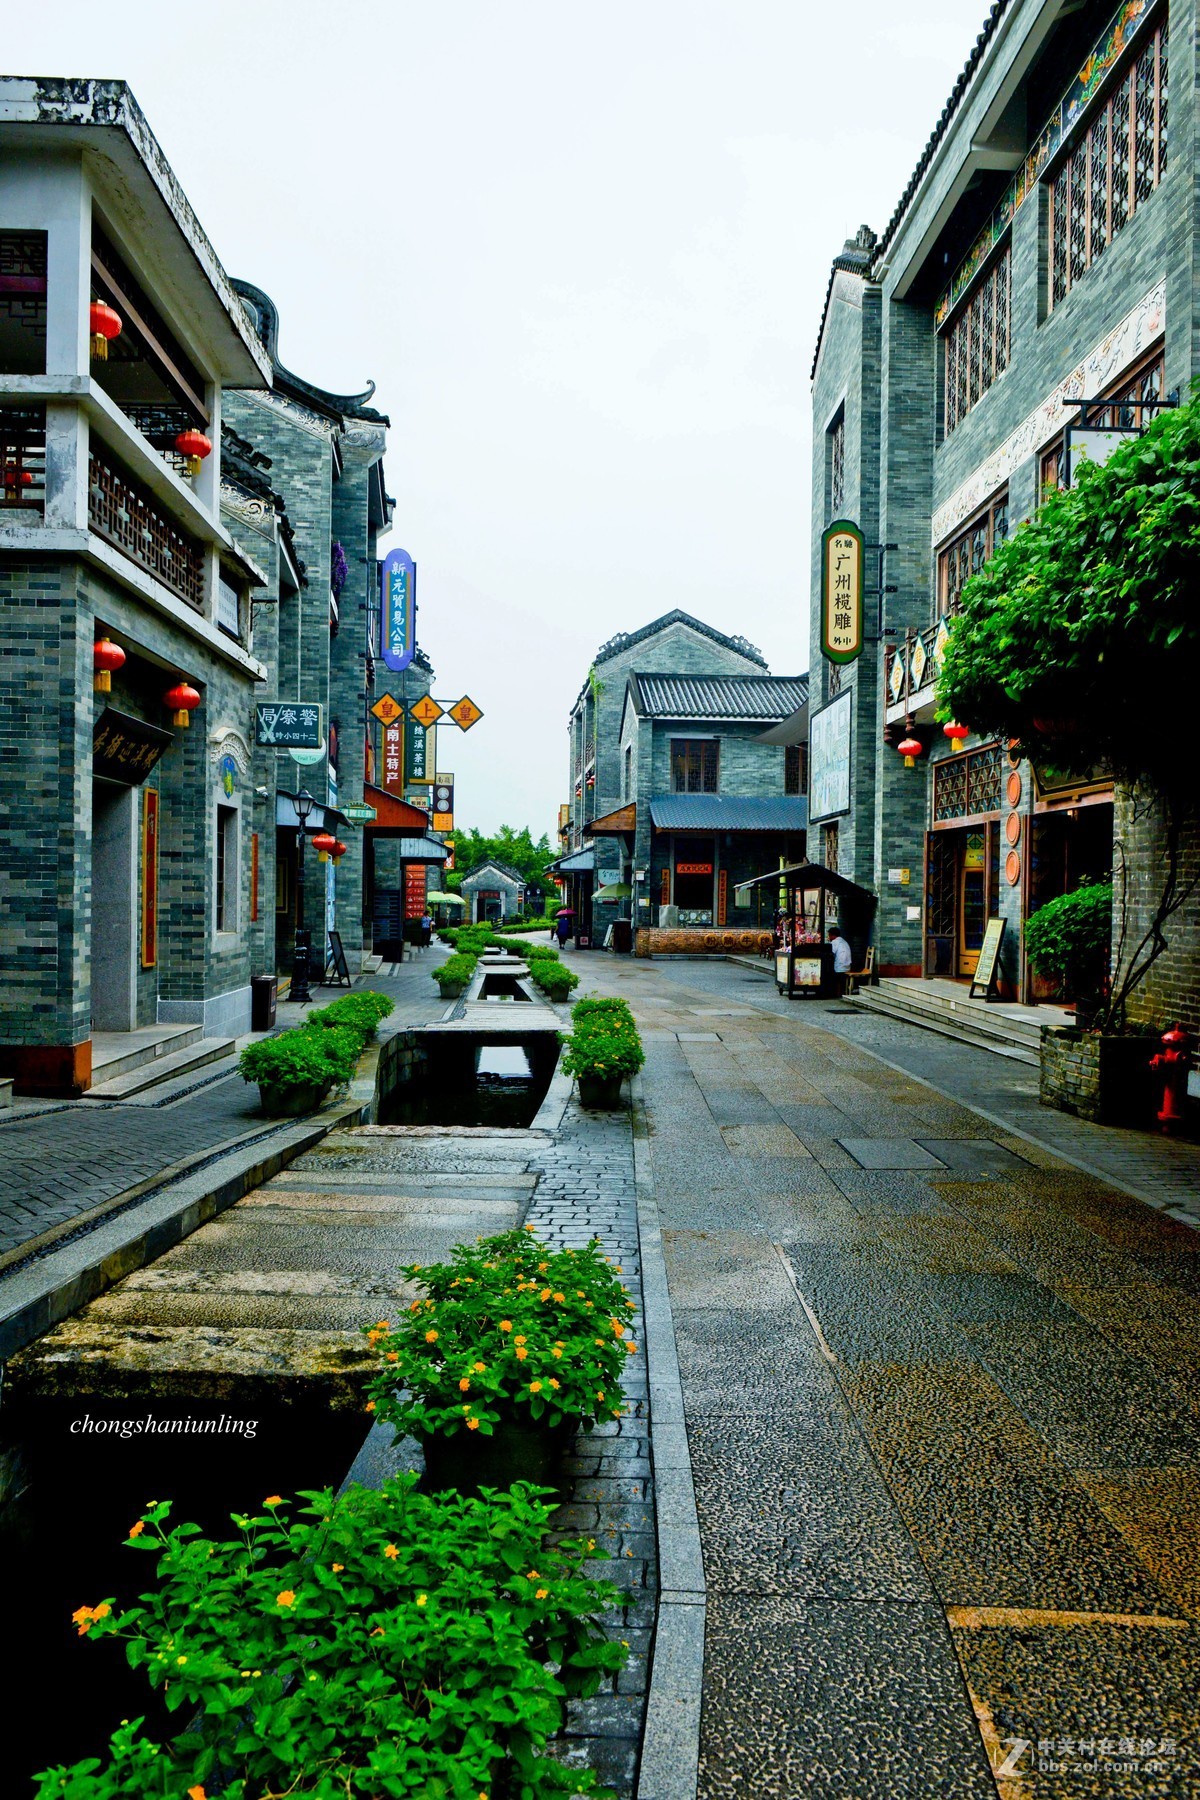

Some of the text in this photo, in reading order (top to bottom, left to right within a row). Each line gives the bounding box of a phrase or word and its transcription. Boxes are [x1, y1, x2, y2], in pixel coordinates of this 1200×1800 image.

[391, 561, 406, 658] 新元貿易公司
[833, 553, 852, 630] 广州榄雕
[386, 722, 399, 784] 南土特产
